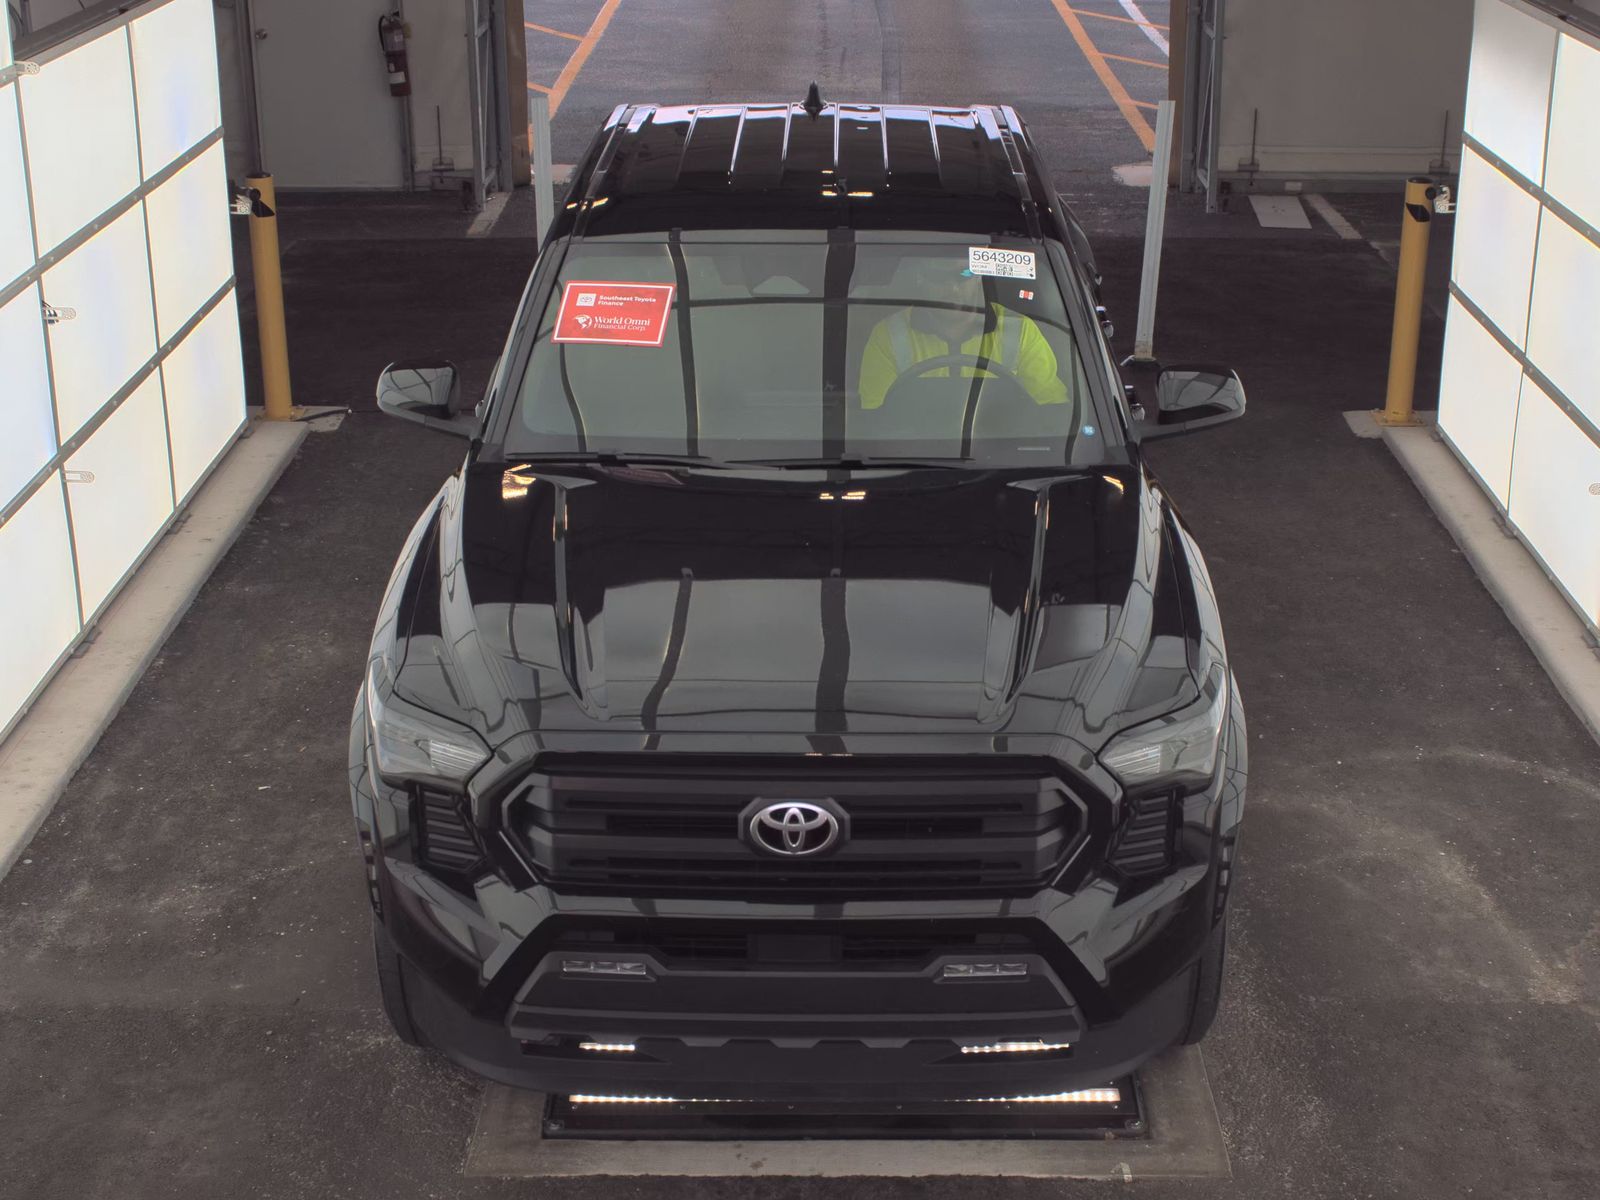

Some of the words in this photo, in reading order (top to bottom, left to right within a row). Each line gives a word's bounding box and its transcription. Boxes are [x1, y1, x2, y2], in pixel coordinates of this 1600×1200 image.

[973, 250, 1031, 265] 5643209
[594, 316, 623, 324] World
[624, 317, 650, 326] Omni
